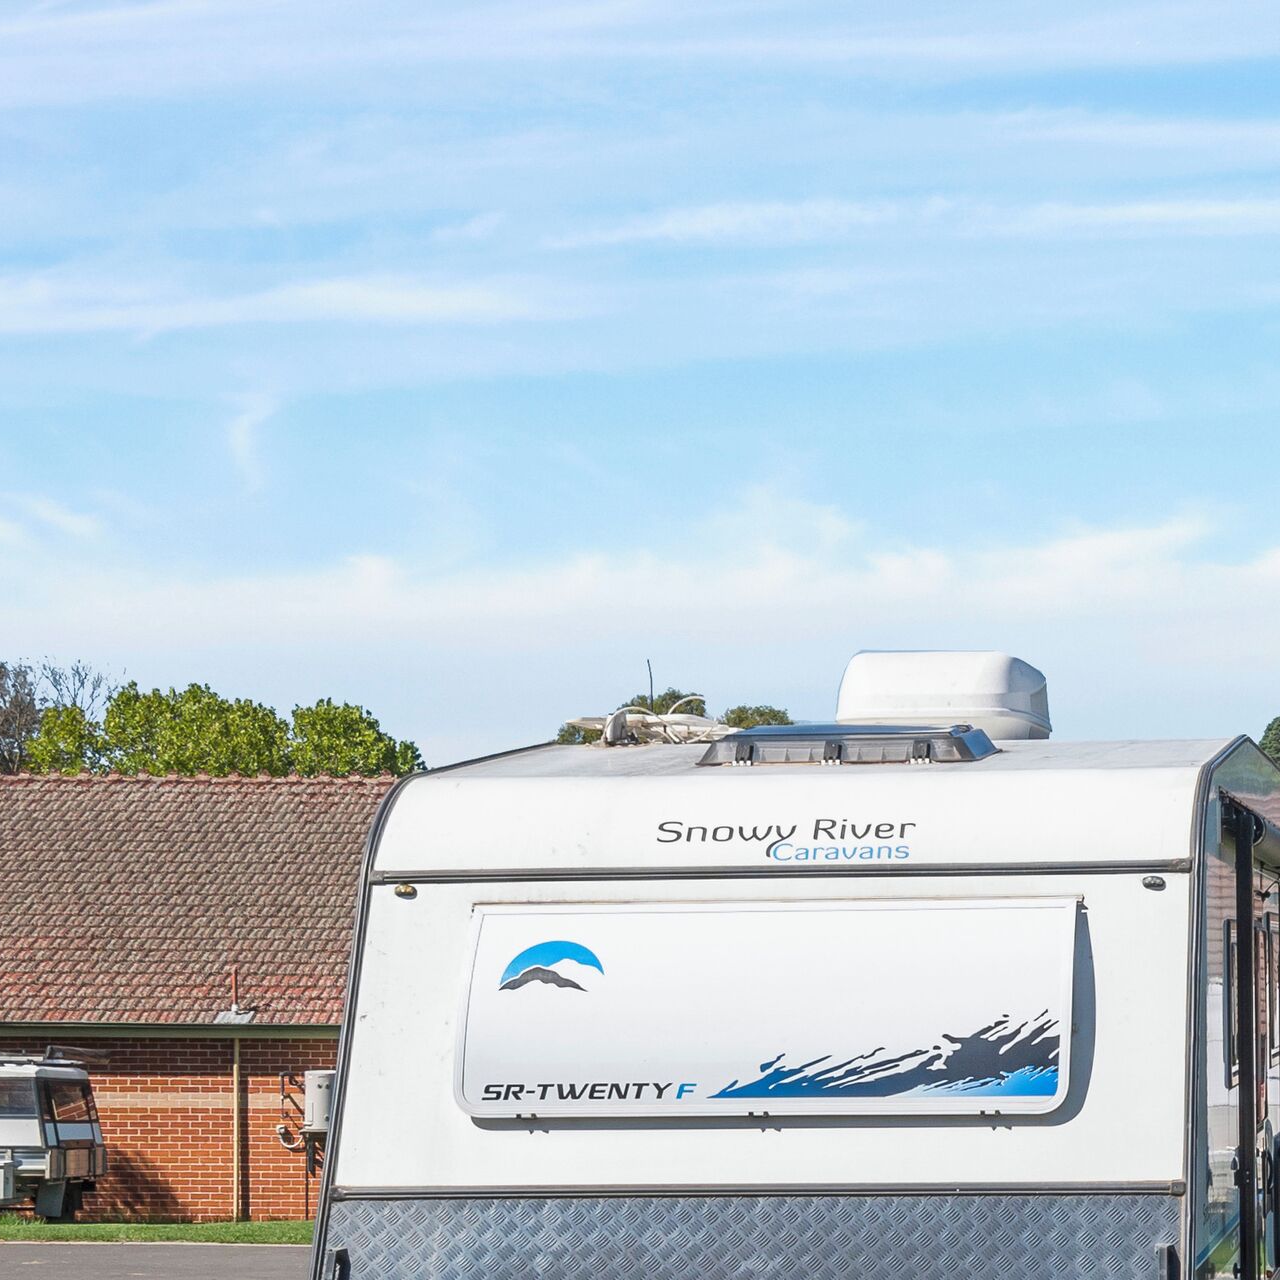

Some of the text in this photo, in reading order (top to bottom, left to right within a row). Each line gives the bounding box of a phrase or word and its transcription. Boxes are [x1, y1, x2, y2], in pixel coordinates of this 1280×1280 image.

[656, 818, 917, 858] Snowy River
[773, 843, 910, 861] Caravans
